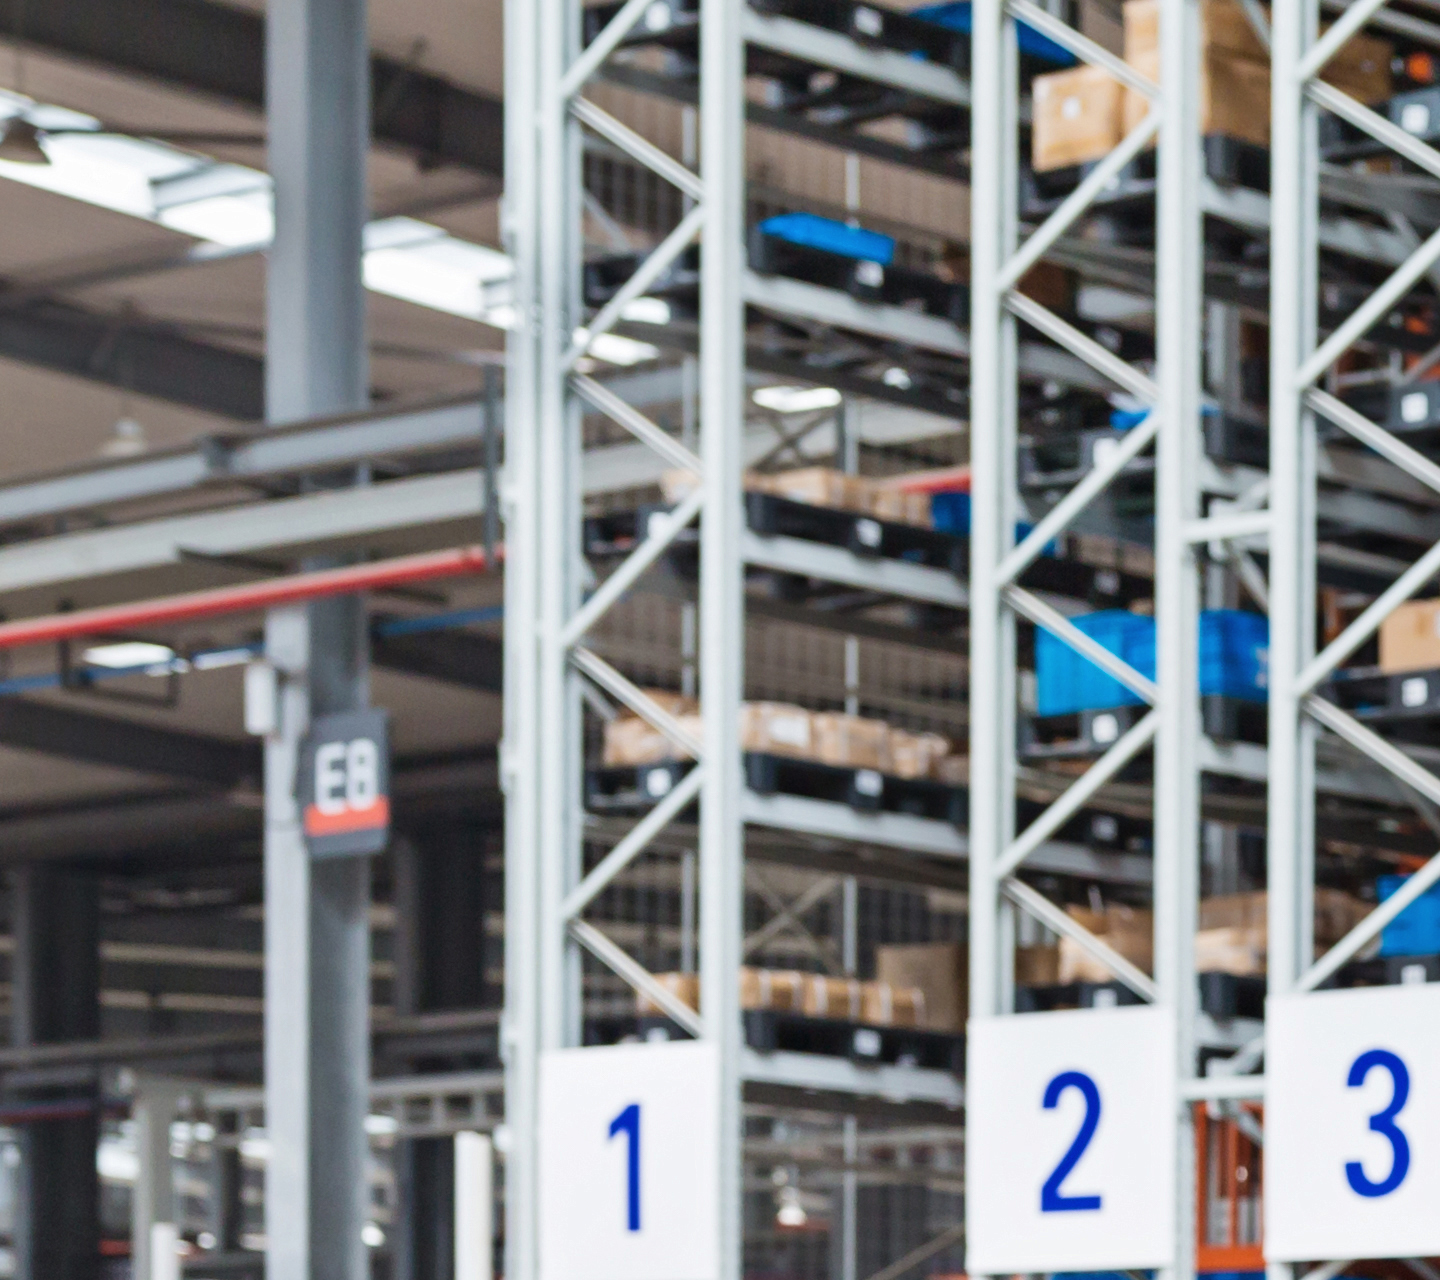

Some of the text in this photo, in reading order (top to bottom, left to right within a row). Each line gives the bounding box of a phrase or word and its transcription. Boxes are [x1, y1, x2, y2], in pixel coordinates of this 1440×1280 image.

[315, 737, 378, 816] E8
[608, 1103, 641, 1232] 1
[1040, 1070, 1103, 1213] 2
[1344, 1048, 1411, 1199] 3
